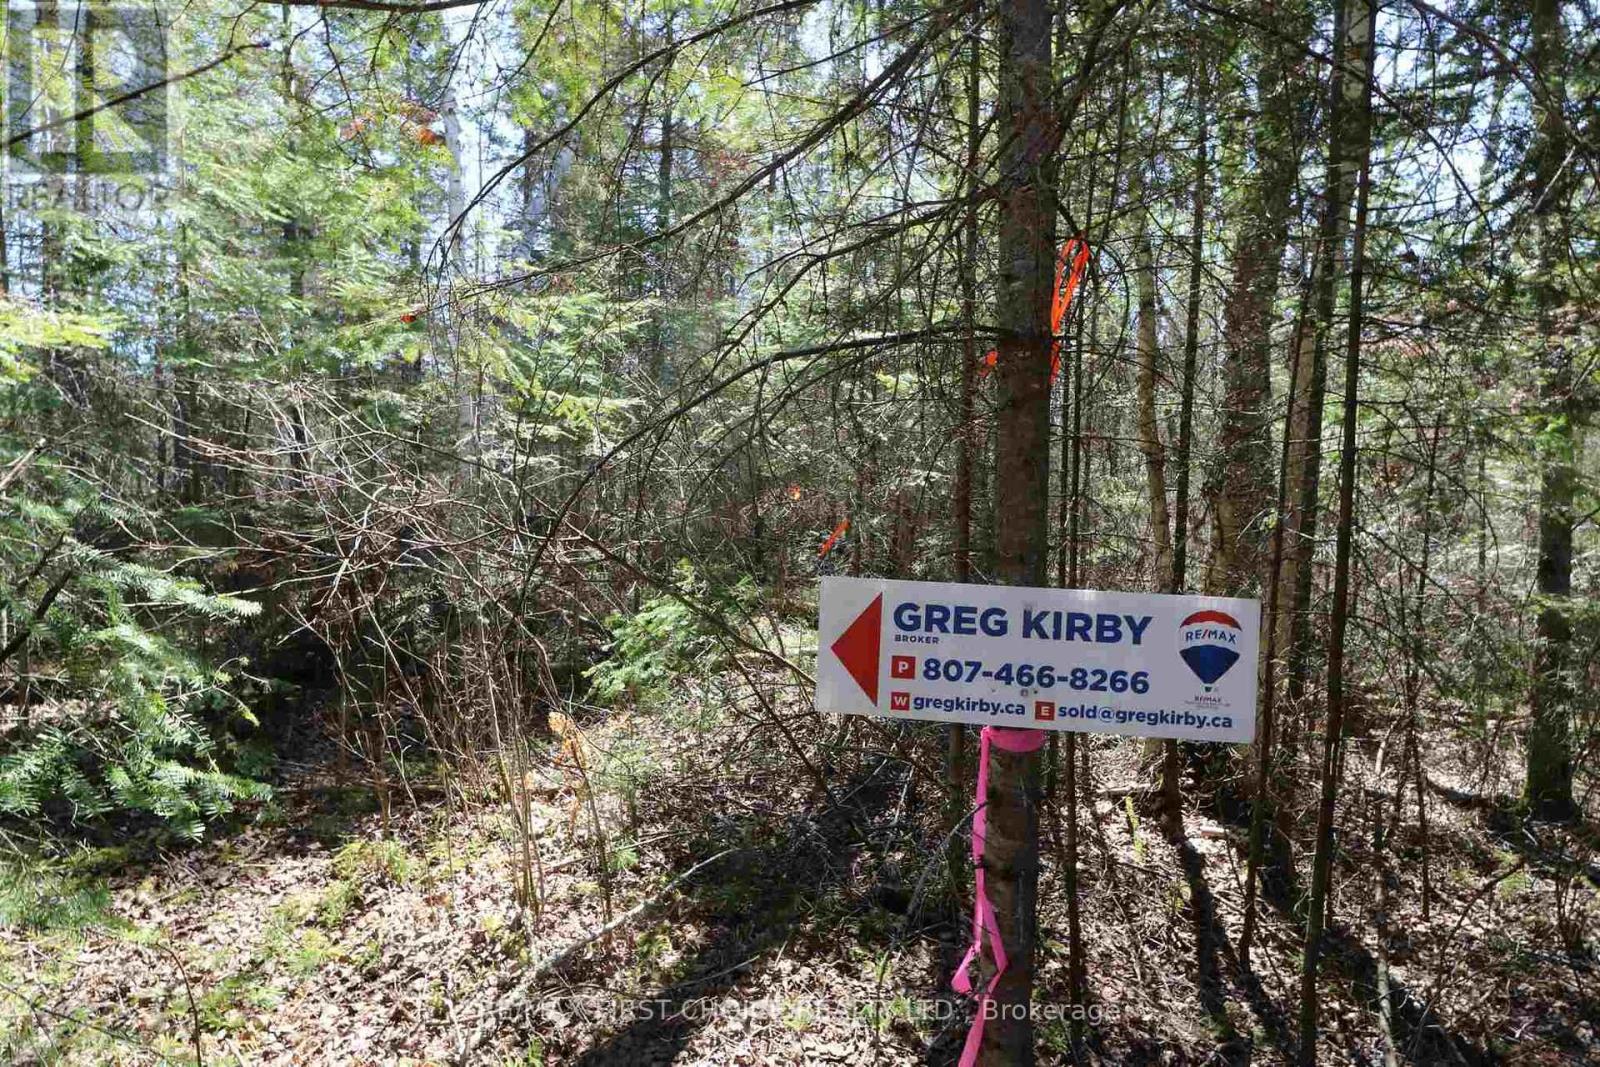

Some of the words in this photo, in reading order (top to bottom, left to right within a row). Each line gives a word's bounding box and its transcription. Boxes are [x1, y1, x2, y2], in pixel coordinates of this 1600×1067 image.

[893, 602, 1008, 637] GREG
[1022, 608, 1153, 645] KIRBY
[894, 634, 940, 645] BROKER
[1185, 629, 1237, 645] RE/MAX
[922, 657, 1150, 695] 807-466-8266
[913, 695, 1026, 716] gregkirby.ca
[1058, 705, 1233, 729] sold@gregkirby.ca
